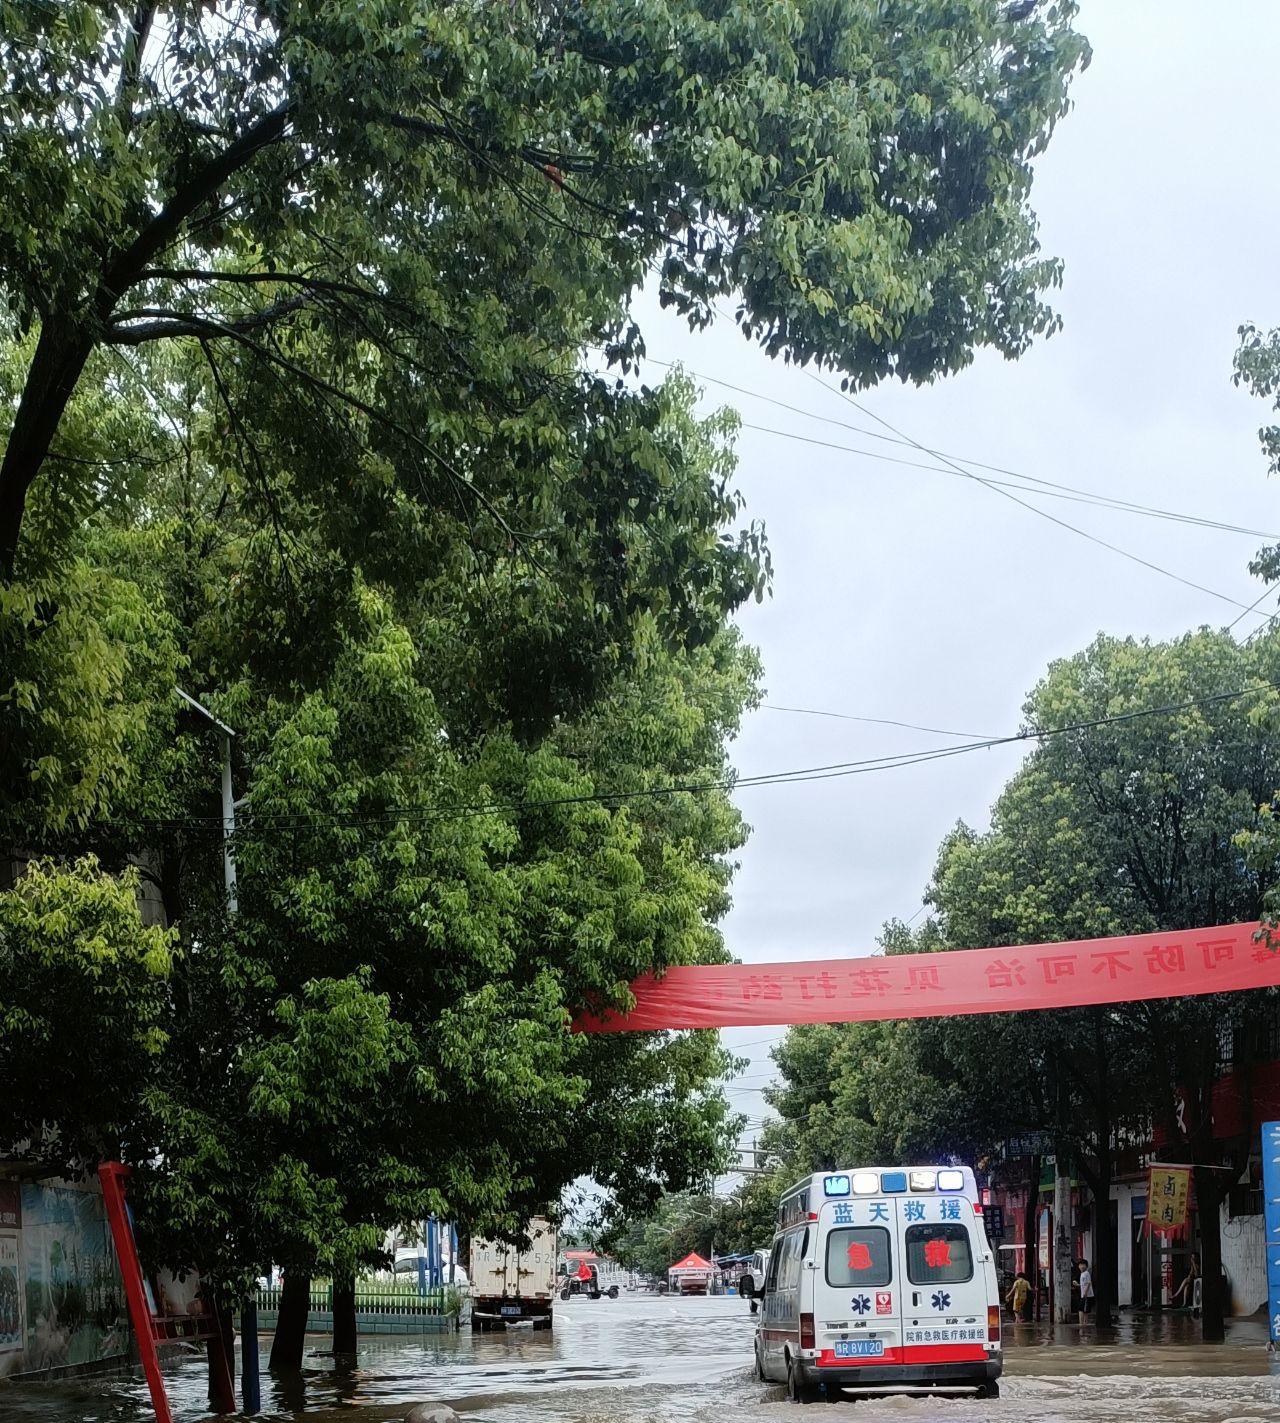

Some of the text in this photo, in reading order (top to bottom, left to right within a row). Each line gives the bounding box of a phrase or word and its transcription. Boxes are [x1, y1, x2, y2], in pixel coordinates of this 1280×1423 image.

[832, 1199, 961, 1224] 蓝天救援
[1161, 1176, 1176, 1223] 卤肉
[847, 1239, 952, 1269] 急 救
[906, 1329, 985, 1342] 院前急救医疗救援组
